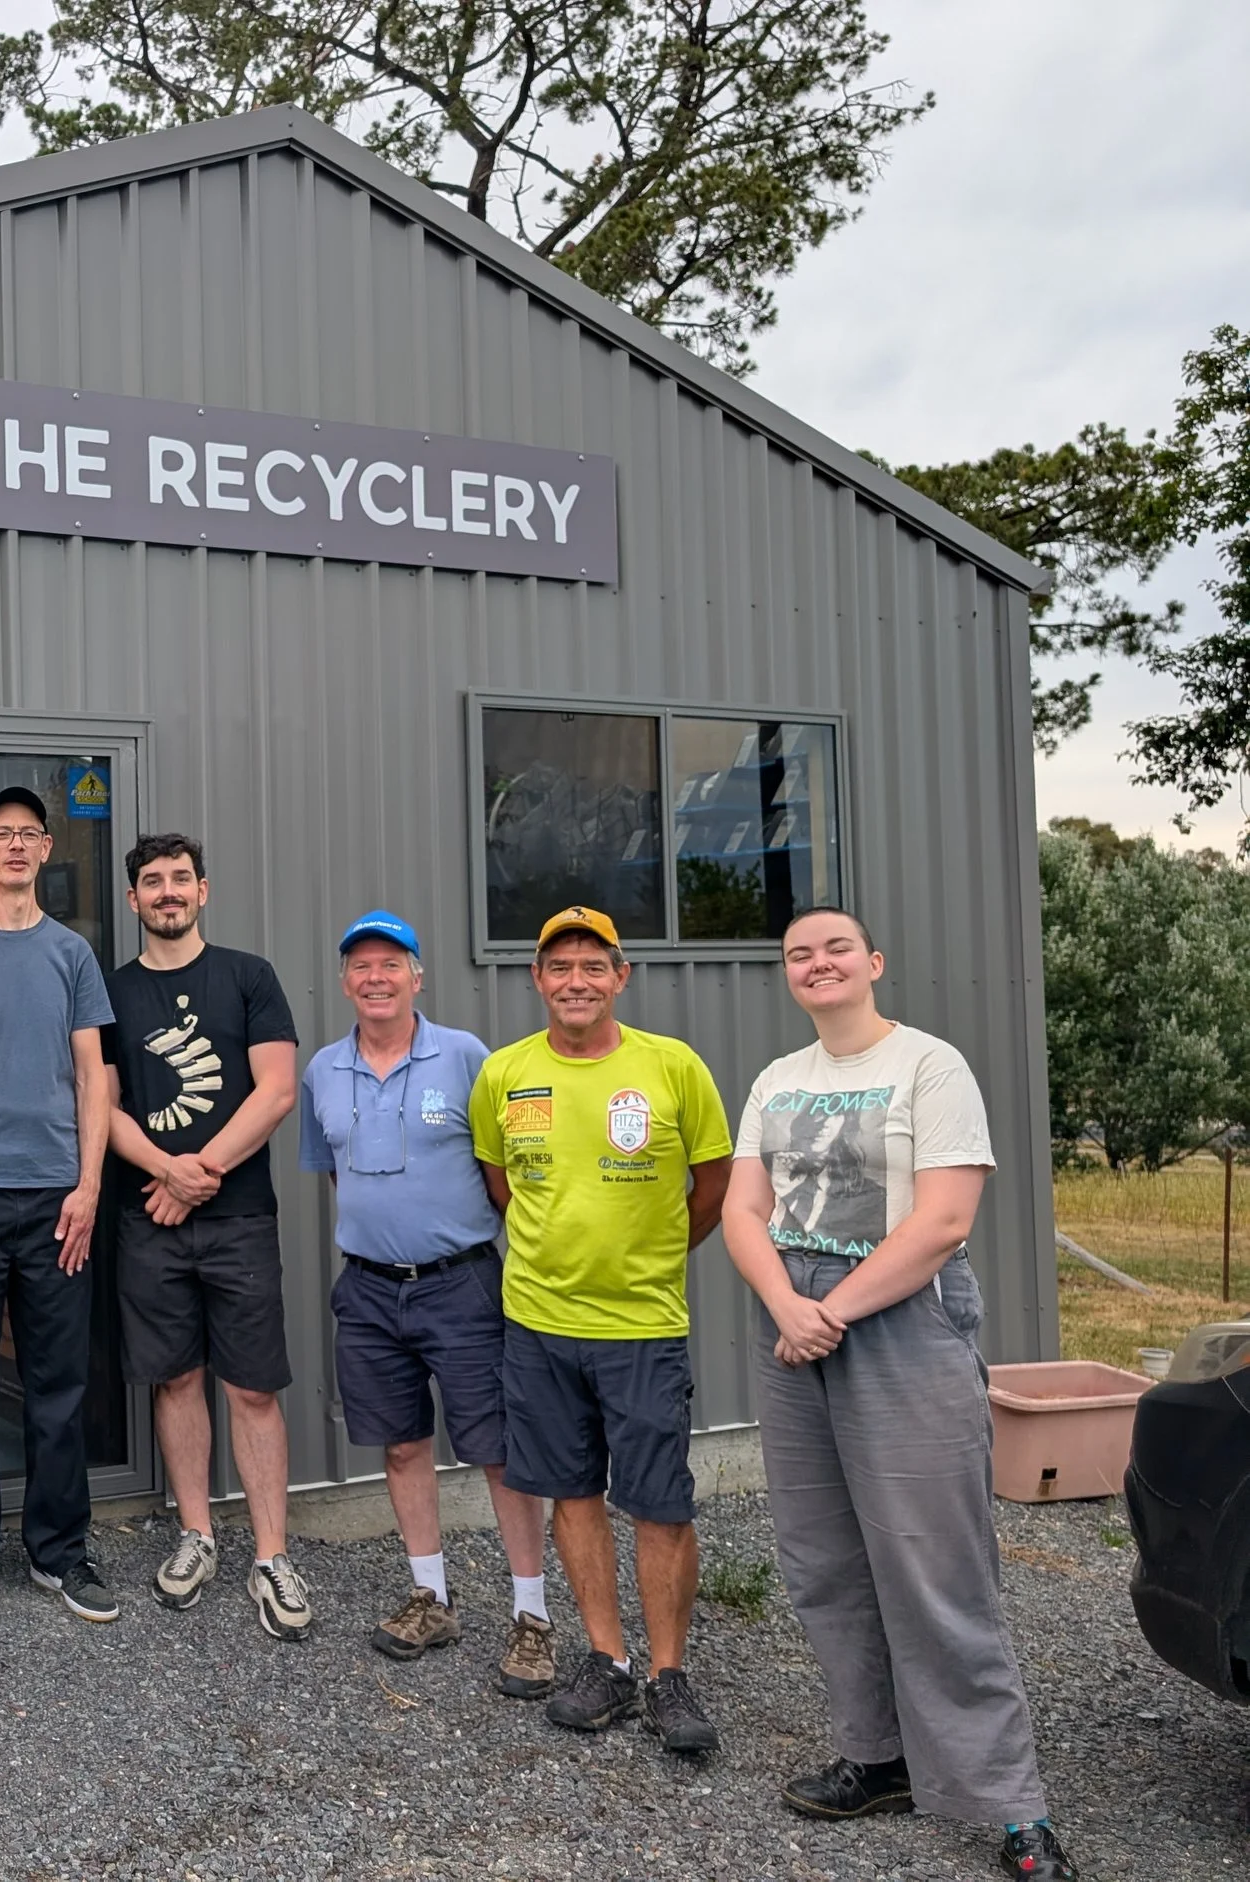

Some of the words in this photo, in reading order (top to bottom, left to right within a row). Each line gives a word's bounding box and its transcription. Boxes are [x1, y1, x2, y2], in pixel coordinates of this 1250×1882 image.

[149, 435, 580, 545] RECYCLERY
[767, 1090, 812, 1112] CAT
[810, 1088, 891, 1116] POWER
[509, 1103, 547, 1122] CAPITAL
[614, 1114, 643, 1127] FITZ'S
[511, 1135, 545, 1146] premax
[530, 1152, 553, 1165] FRESH
[615, 1175, 643, 1183] Canberra
